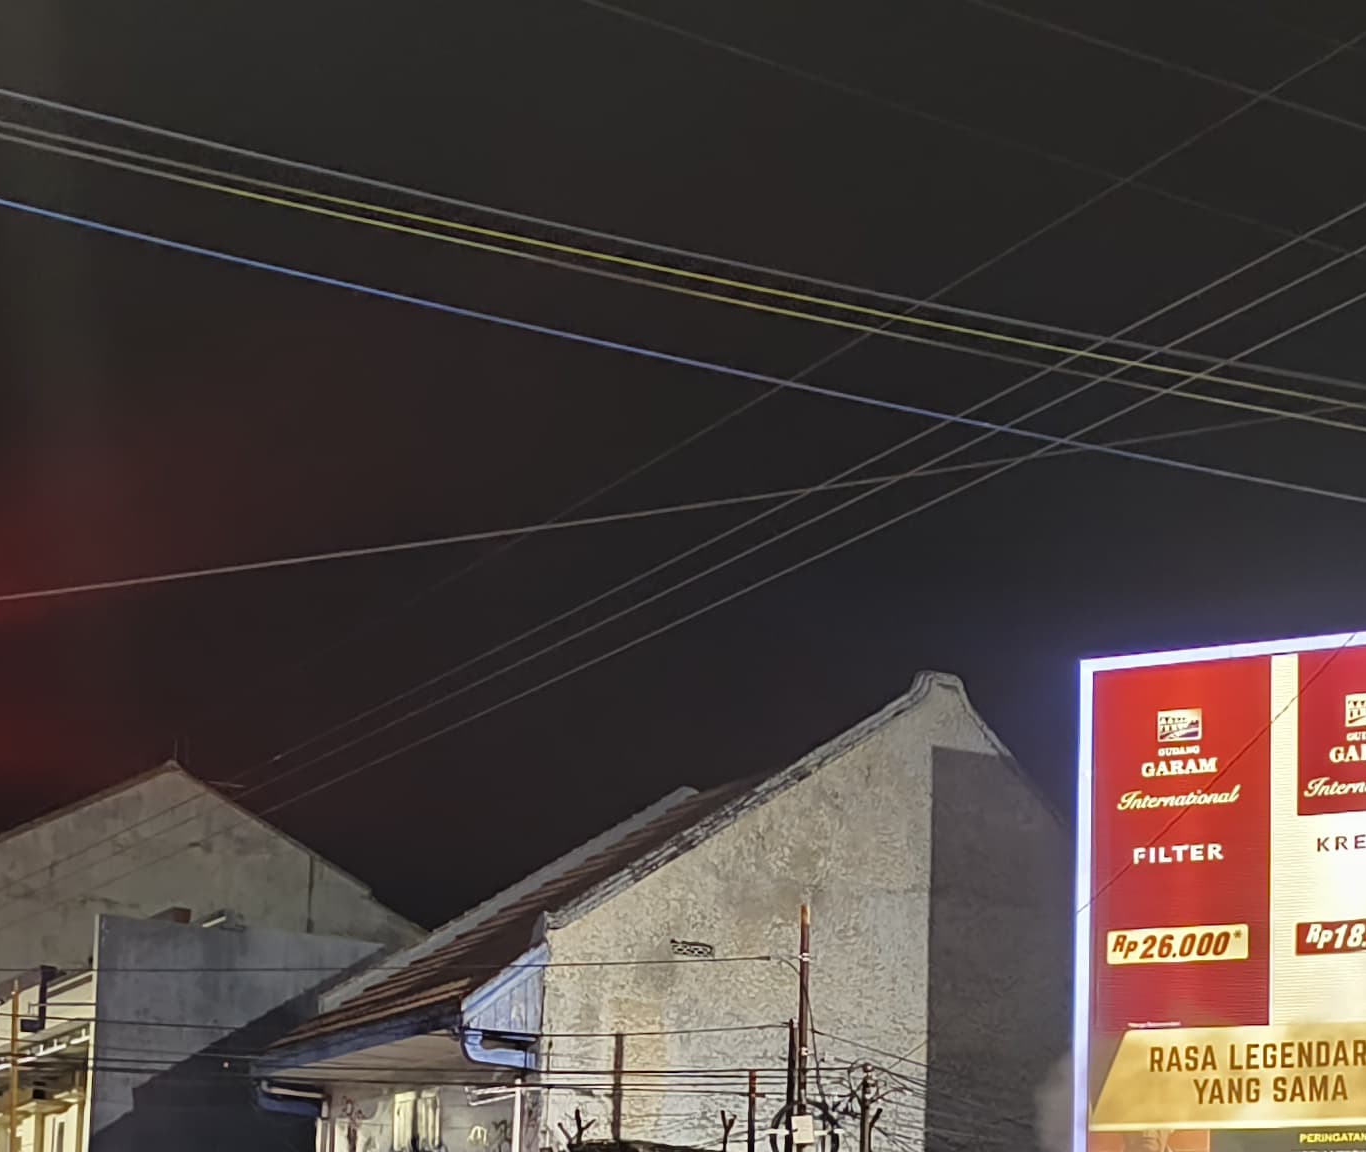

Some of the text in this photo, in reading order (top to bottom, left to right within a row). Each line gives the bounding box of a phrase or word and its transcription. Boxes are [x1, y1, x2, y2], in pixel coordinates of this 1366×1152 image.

[1141, 757, 1218, 777] GARAM
[1117, 784, 1241, 811] International
[1133, 843, 1223, 864] FILTER
[1149, 1045, 1217, 1073] RASA
[1194, 1075, 1348, 1105] YANG SAMA
